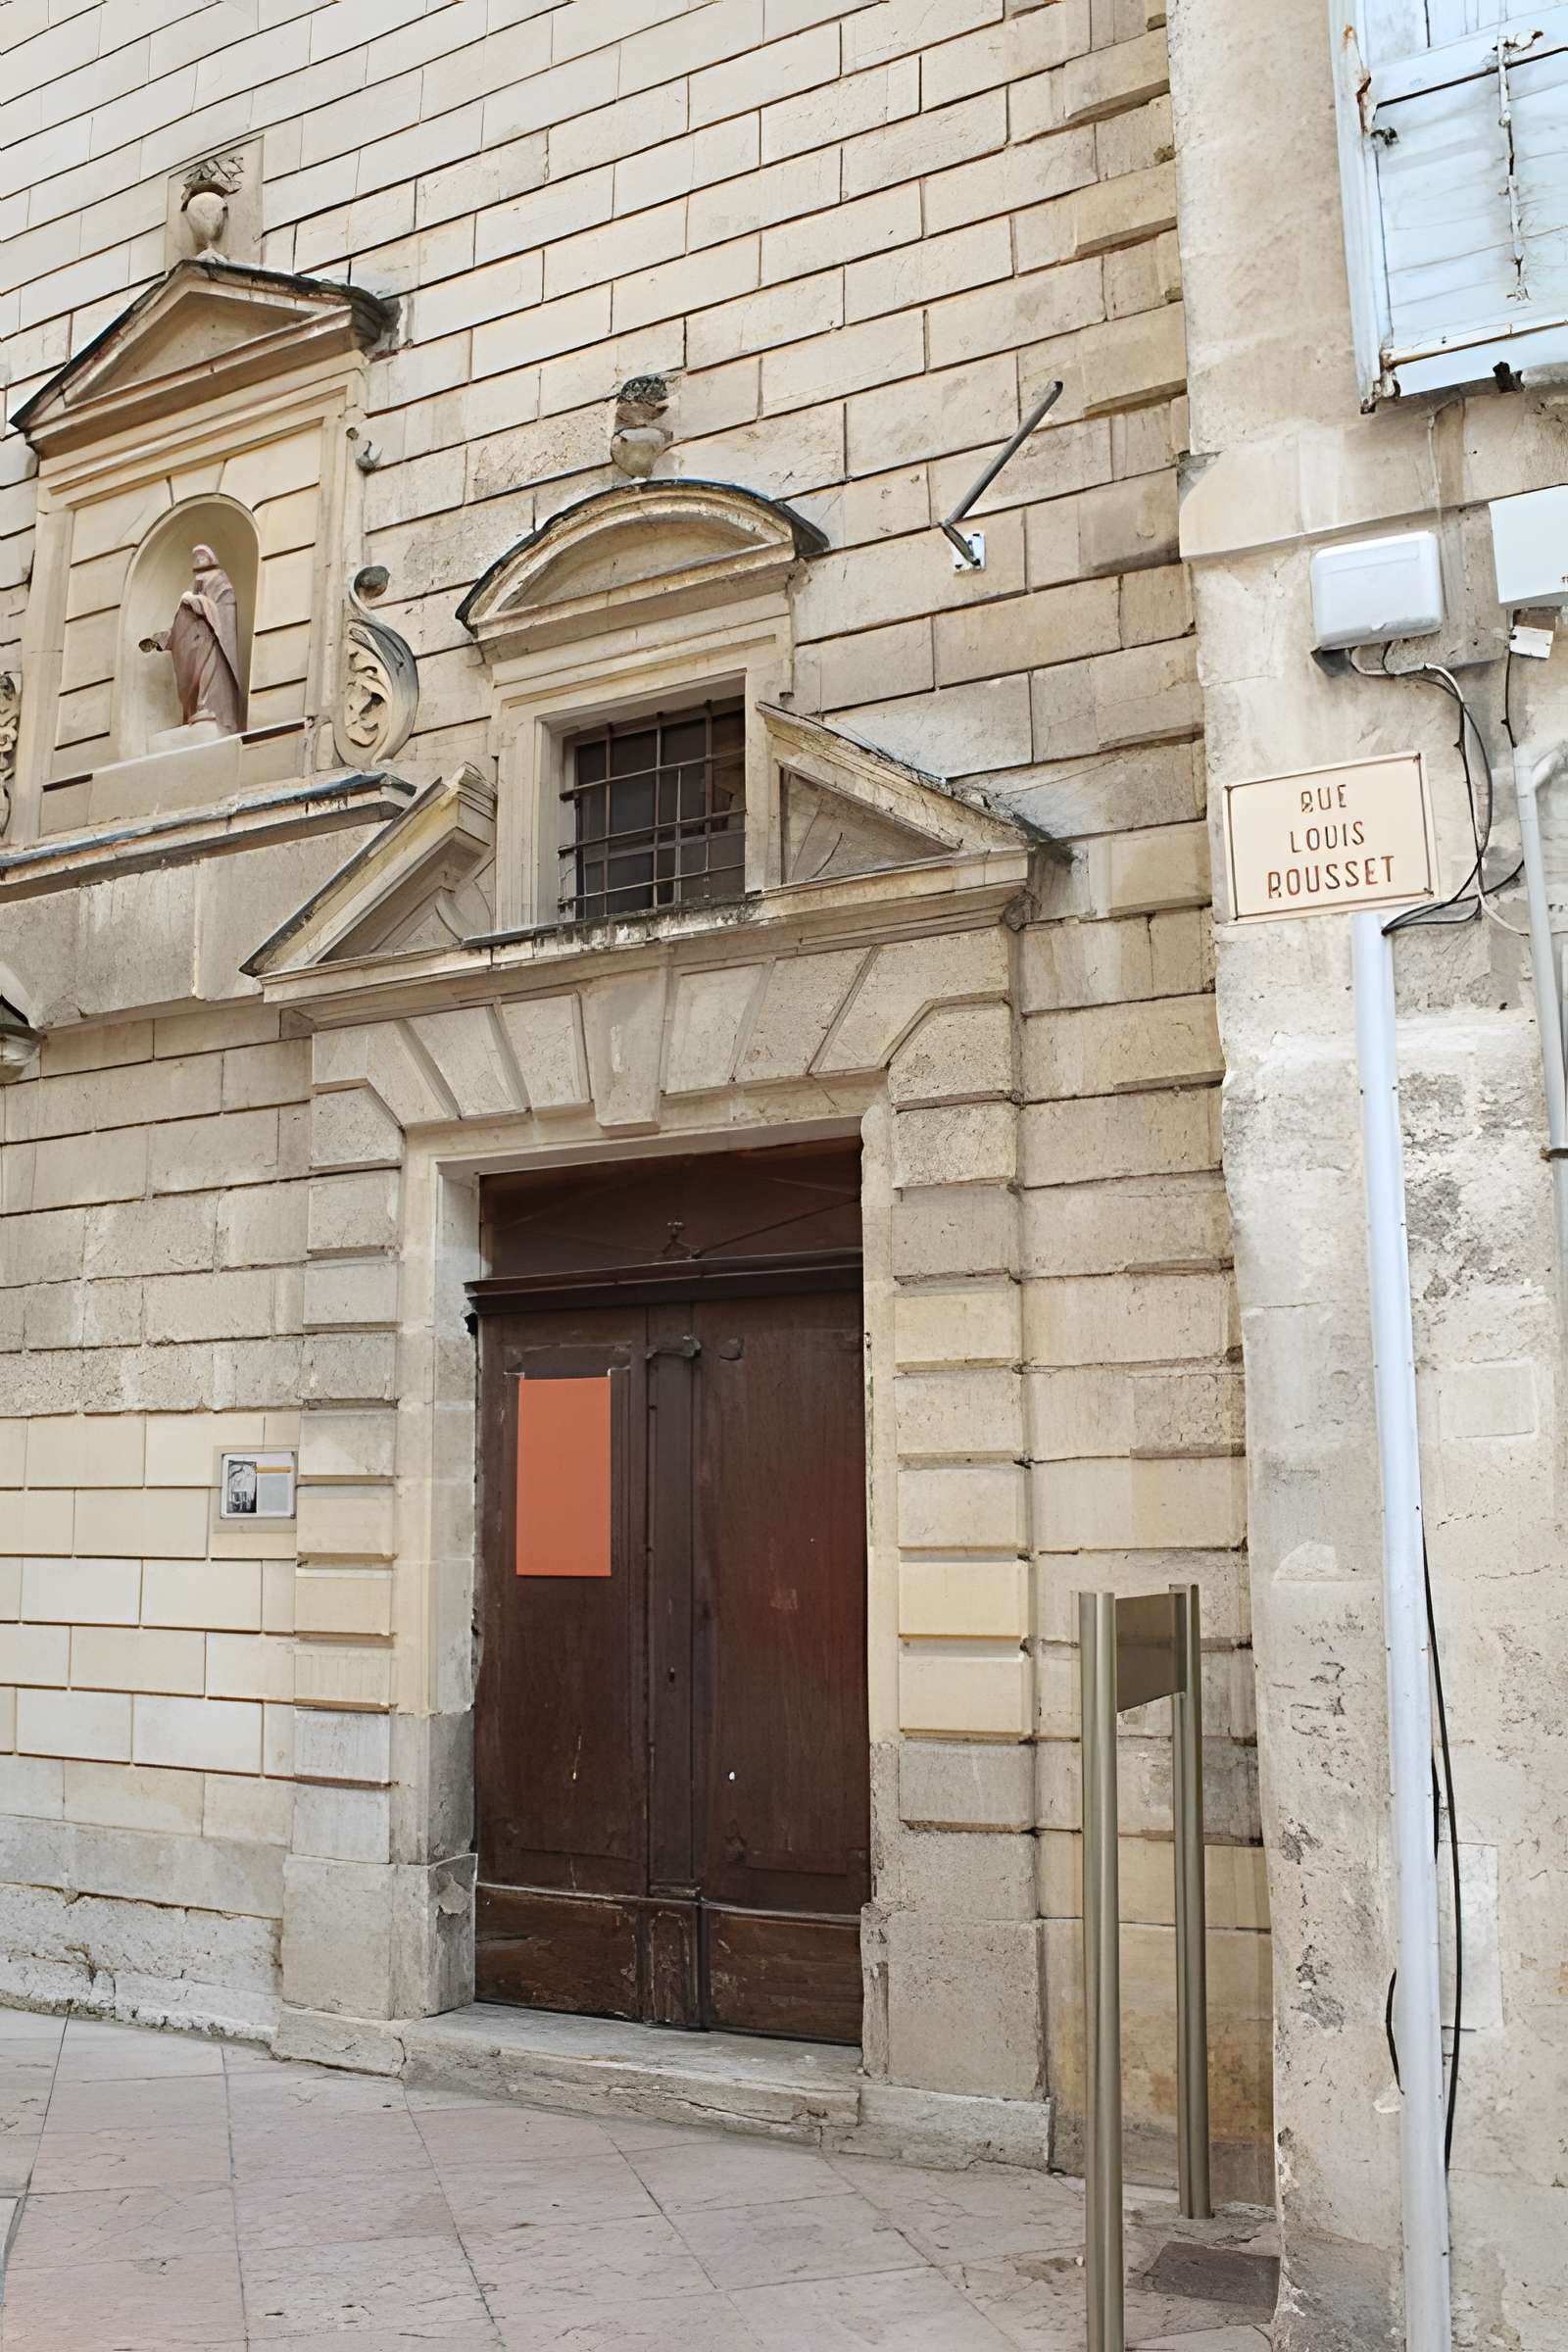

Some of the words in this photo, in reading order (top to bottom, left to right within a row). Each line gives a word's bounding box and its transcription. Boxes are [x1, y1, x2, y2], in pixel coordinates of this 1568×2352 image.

[1301, 784, 1348, 812] RUE
[1290, 821, 1365, 853] LOUIS
[1268, 856, 1395, 899] ROUSSET
